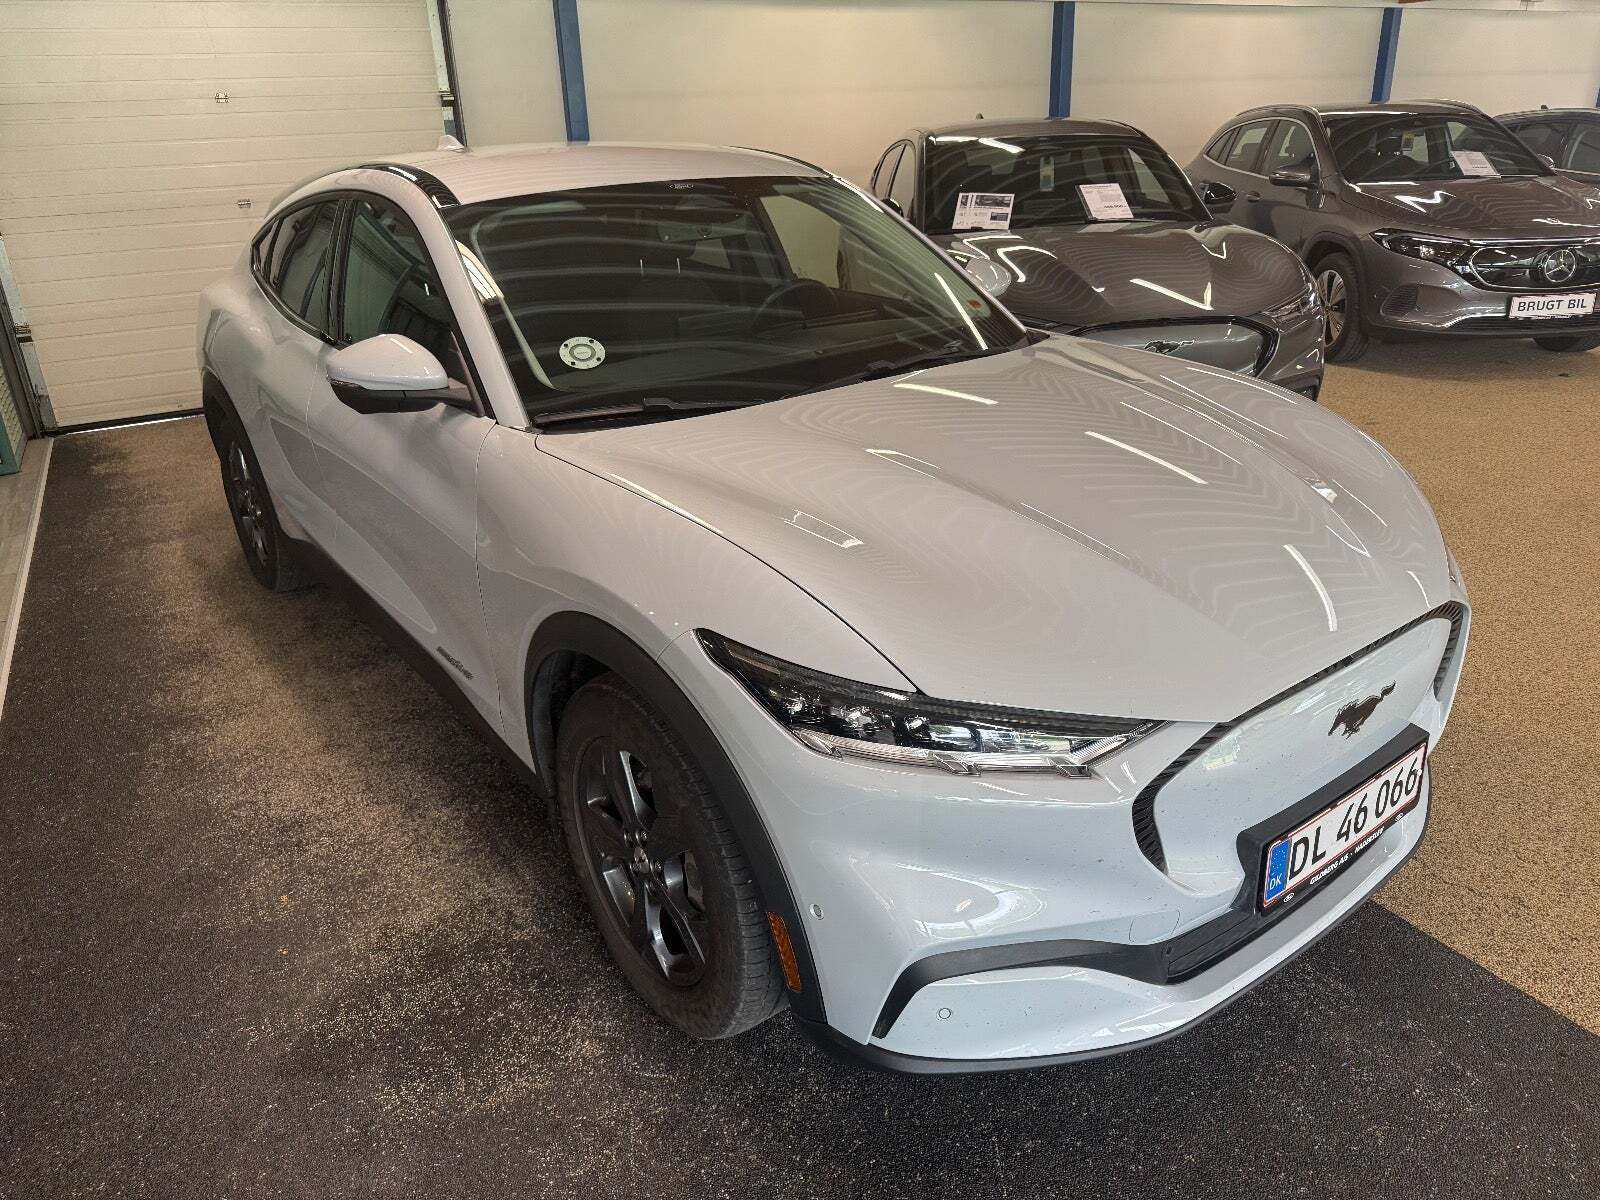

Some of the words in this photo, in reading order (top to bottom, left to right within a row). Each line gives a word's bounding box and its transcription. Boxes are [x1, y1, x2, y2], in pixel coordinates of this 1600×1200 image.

[1517, 299, 1564, 312] BRUGT
[1567, 298, 1587, 309] BIL
[1289, 825, 1327, 881] DL
[1336, 792, 1368, 842] 46
[1375, 757, 1418, 819] 066
[1269, 873, 1282, 891] DK
